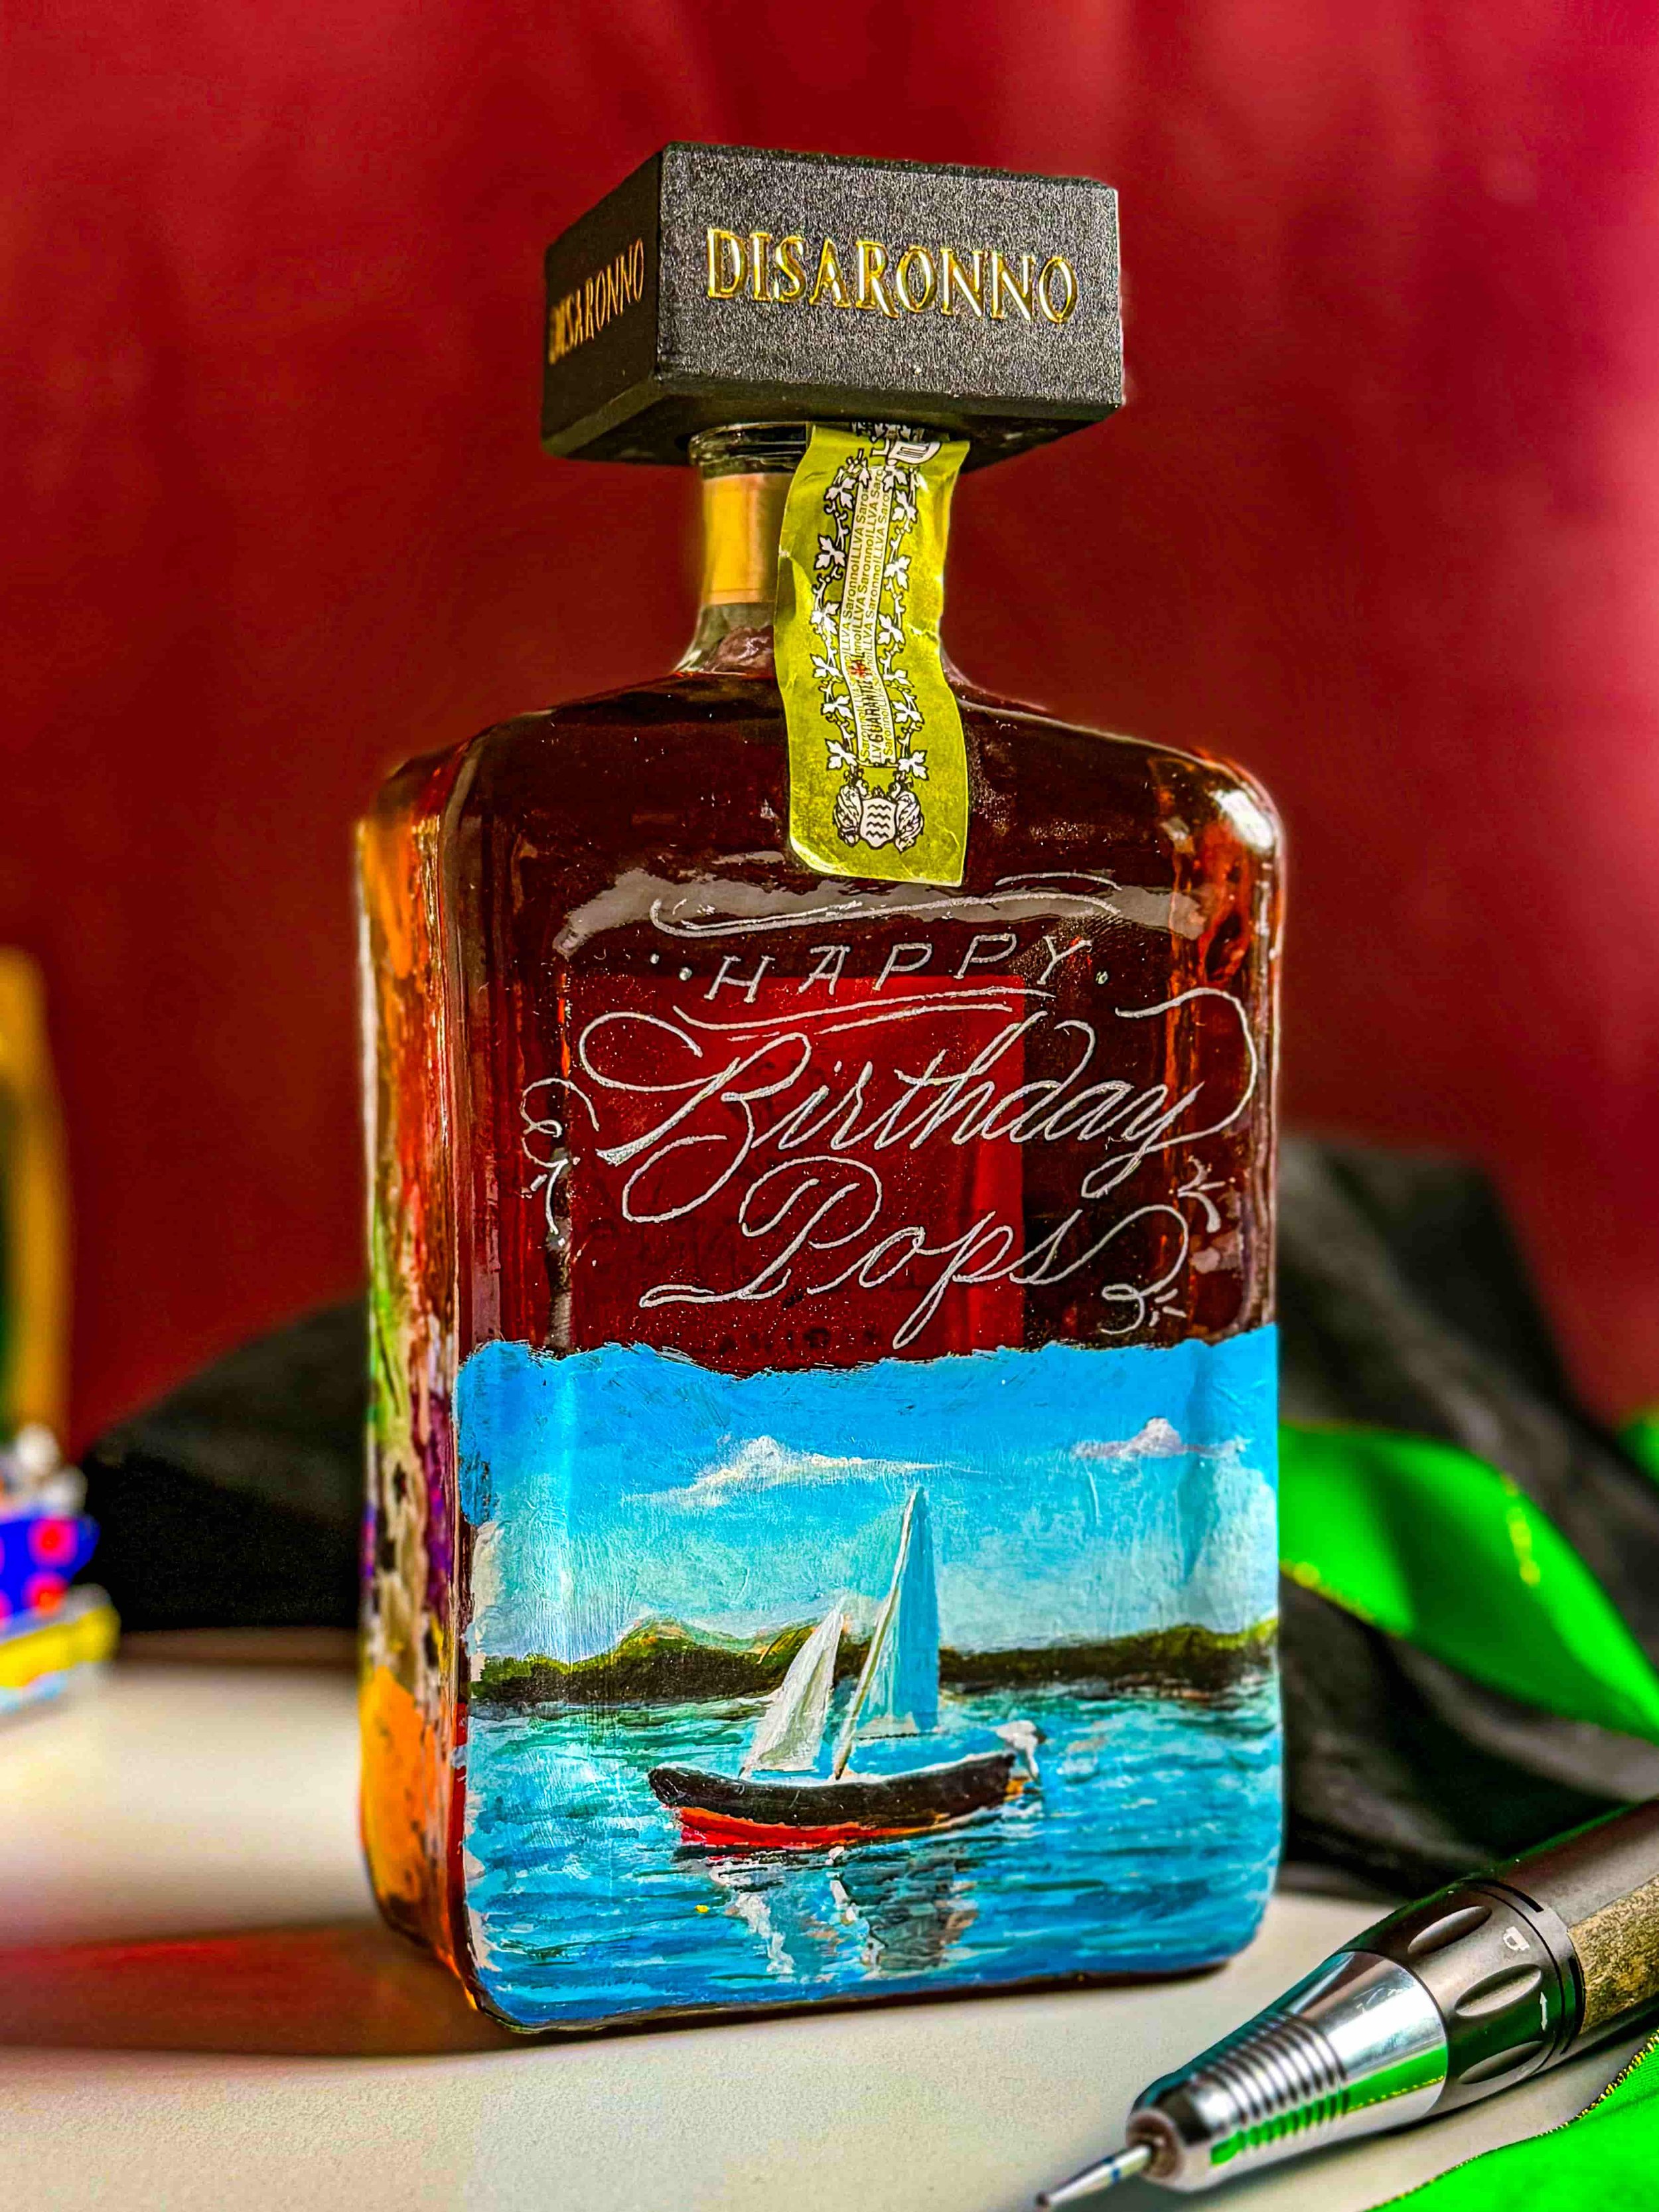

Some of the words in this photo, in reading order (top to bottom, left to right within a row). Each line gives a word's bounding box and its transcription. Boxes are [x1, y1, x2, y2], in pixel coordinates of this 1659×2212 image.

[706, 227, 1078, 325] DISARONNO
[704, 933, 1093, 1003] HAPPY
[579, 988, 1258, 1223] Birthday
[639, 1155, 1189, 1349] Pops
